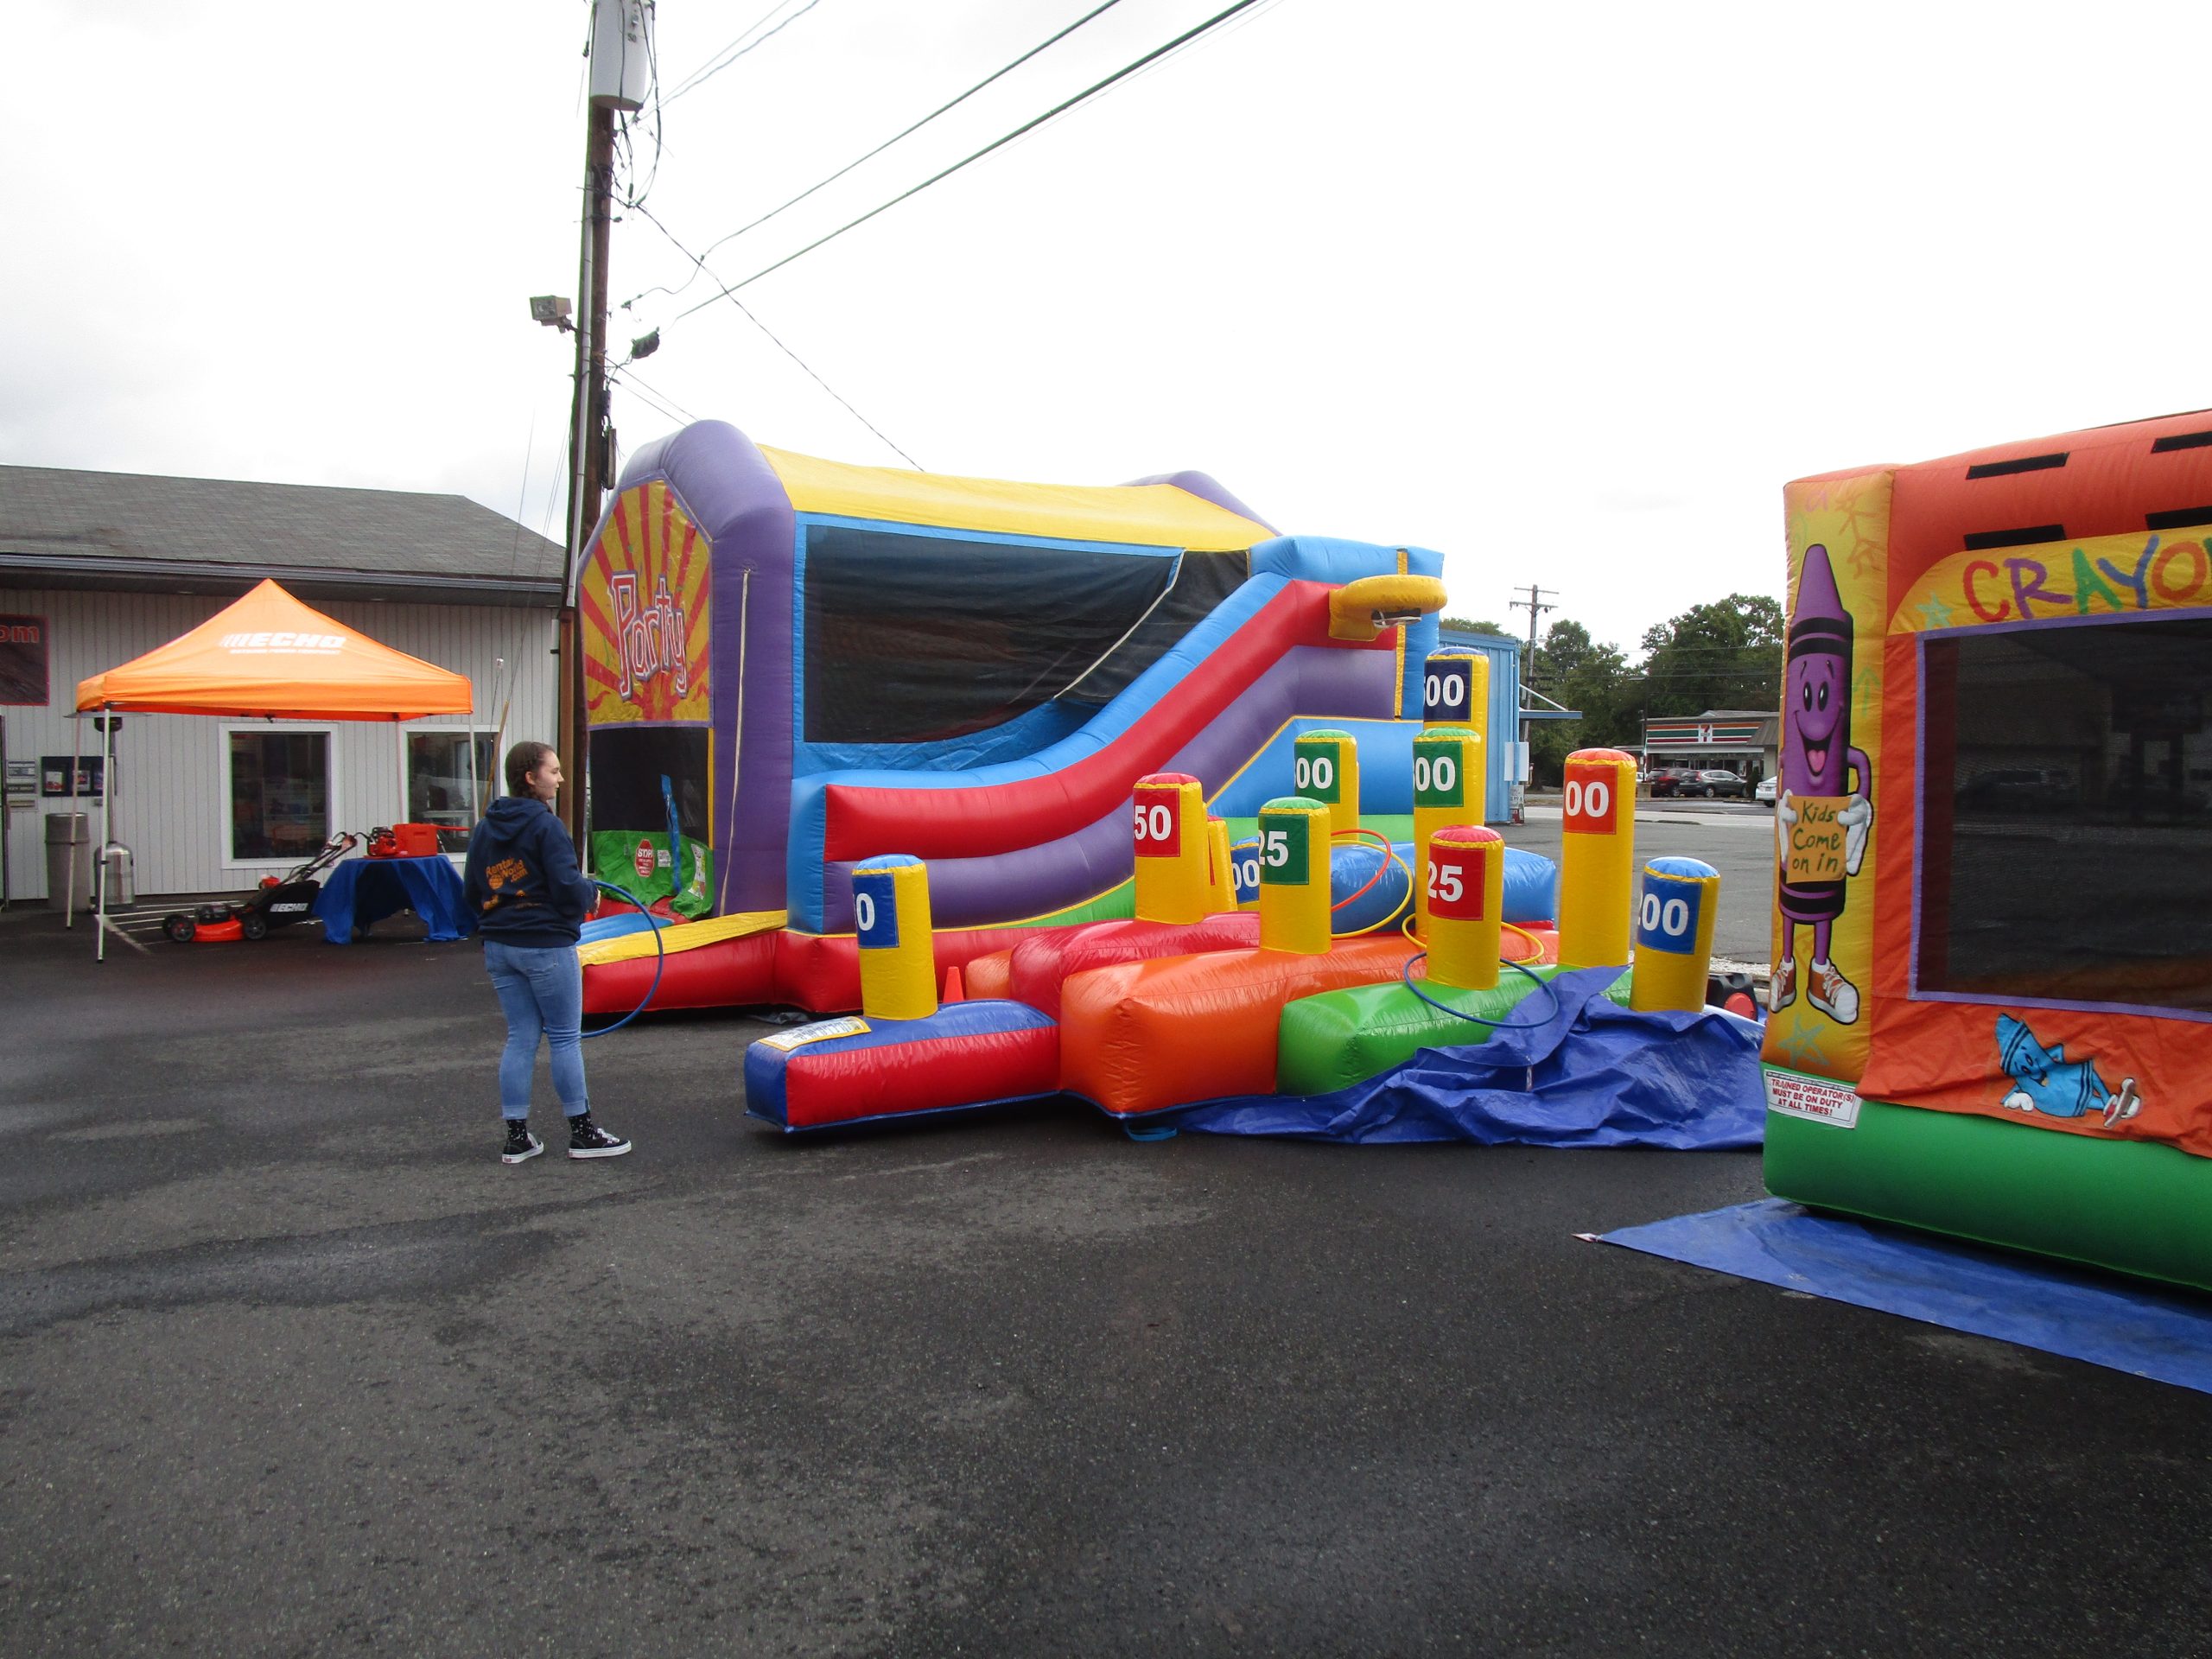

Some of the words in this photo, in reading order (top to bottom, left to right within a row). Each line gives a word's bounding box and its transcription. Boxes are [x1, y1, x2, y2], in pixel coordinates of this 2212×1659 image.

[1963, 533, 2212, 623] CRAYO
[248, 632, 346, 648] ECHO
[612, 570, 689, 702] Party
[1423, 674, 1465, 707] 00
[1294, 757, 1333, 790] 00
[1412, 756, 1456, 792] 00
[1565, 780, 1610, 818] 00
[1802, 800, 1836, 824] Kids
[1134, 804, 1172, 841] 50
[1793, 827, 1842, 850] Come
[1792, 857, 1809, 874] on
[1817, 853, 1839, 873] in
[276, 903, 308, 912] ECHO
[853, 893, 875, 931] 0
[1637, 889, 1689, 937] 00
[1771, 1078, 1802, 1091] TRAINED
[1802, 1085, 1855, 1103] OPERATOR(S)
[1772, 1088, 1791, 1098] MUST
[1793, 1092, 1804, 1101] BE
[1806, 1094, 1817, 1103] ON
[1820, 1097, 1843, 1109] DUTY
[1789, 1101, 1802, 1109] ALL
[1805, 1103, 1833, 1116] TIMES!
